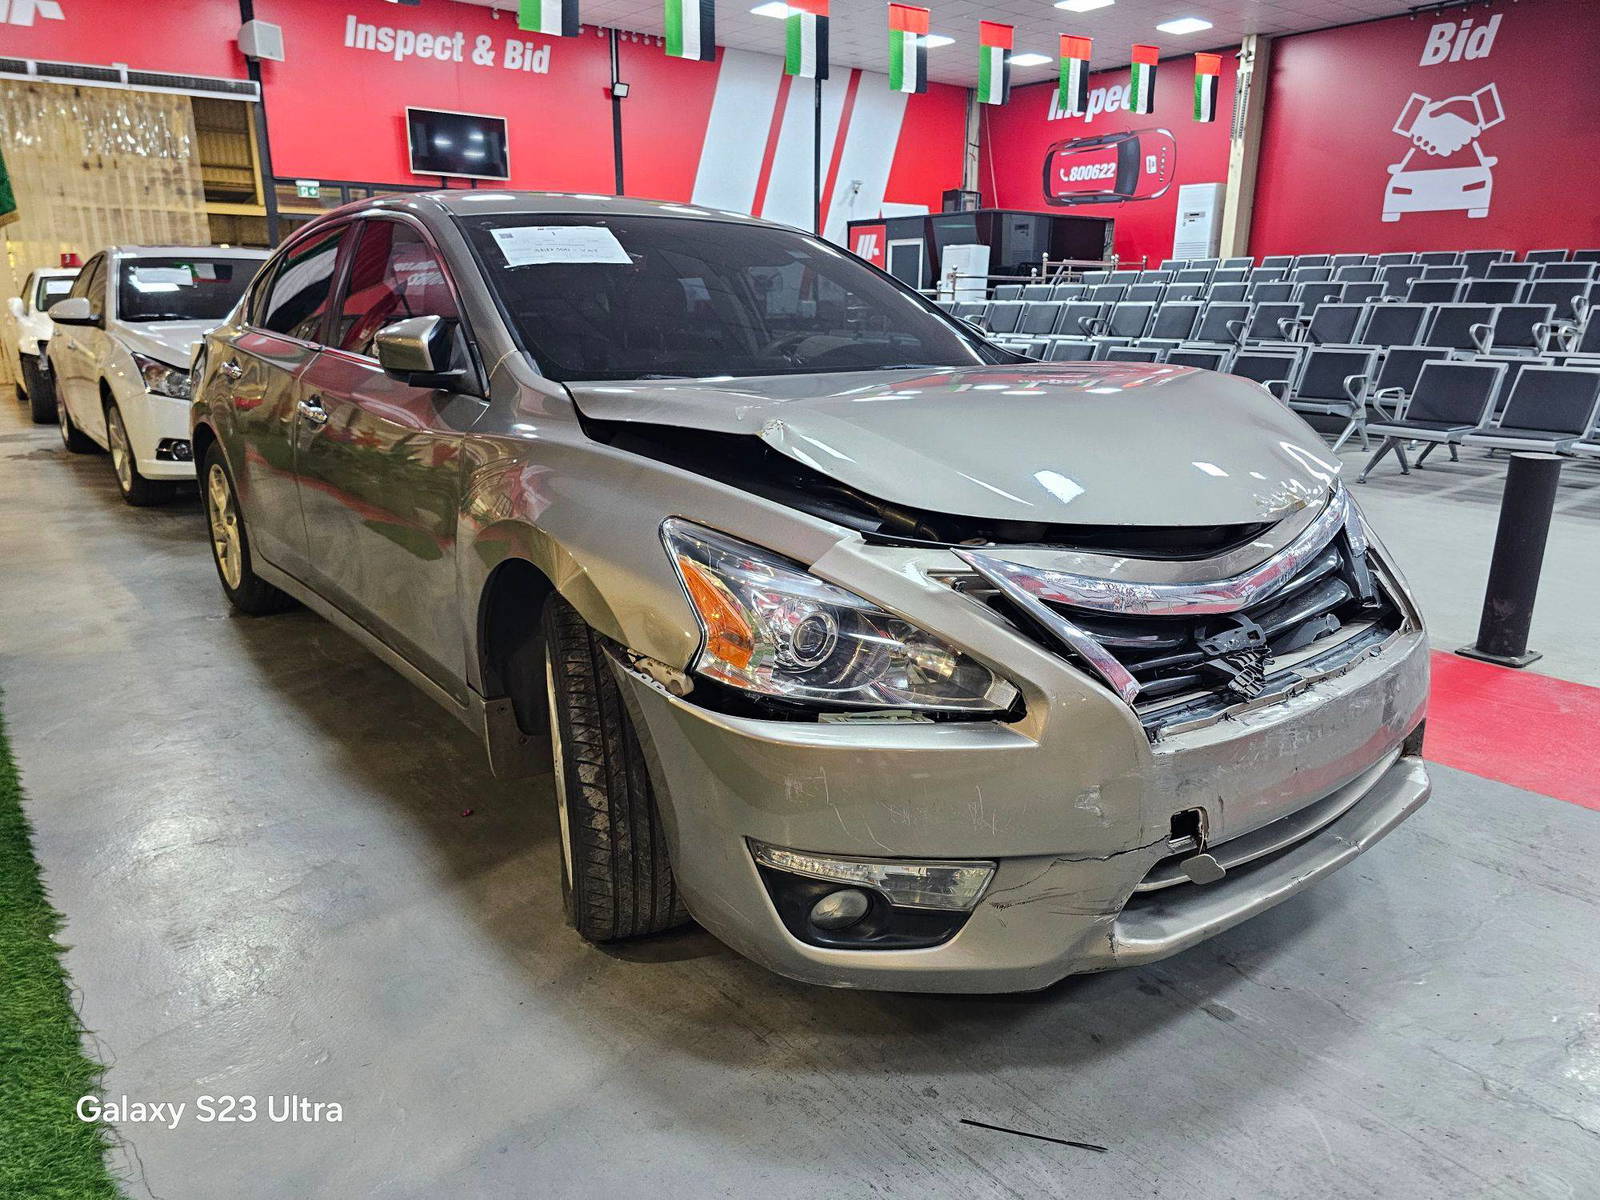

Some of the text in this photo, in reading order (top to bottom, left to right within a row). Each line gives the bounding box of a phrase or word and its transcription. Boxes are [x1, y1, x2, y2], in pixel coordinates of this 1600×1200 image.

[344, 14, 551, 74] Inspect & Bid
[1419, 13, 1504, 67] Bid
[1070, 162, 1117, 182] 800622
